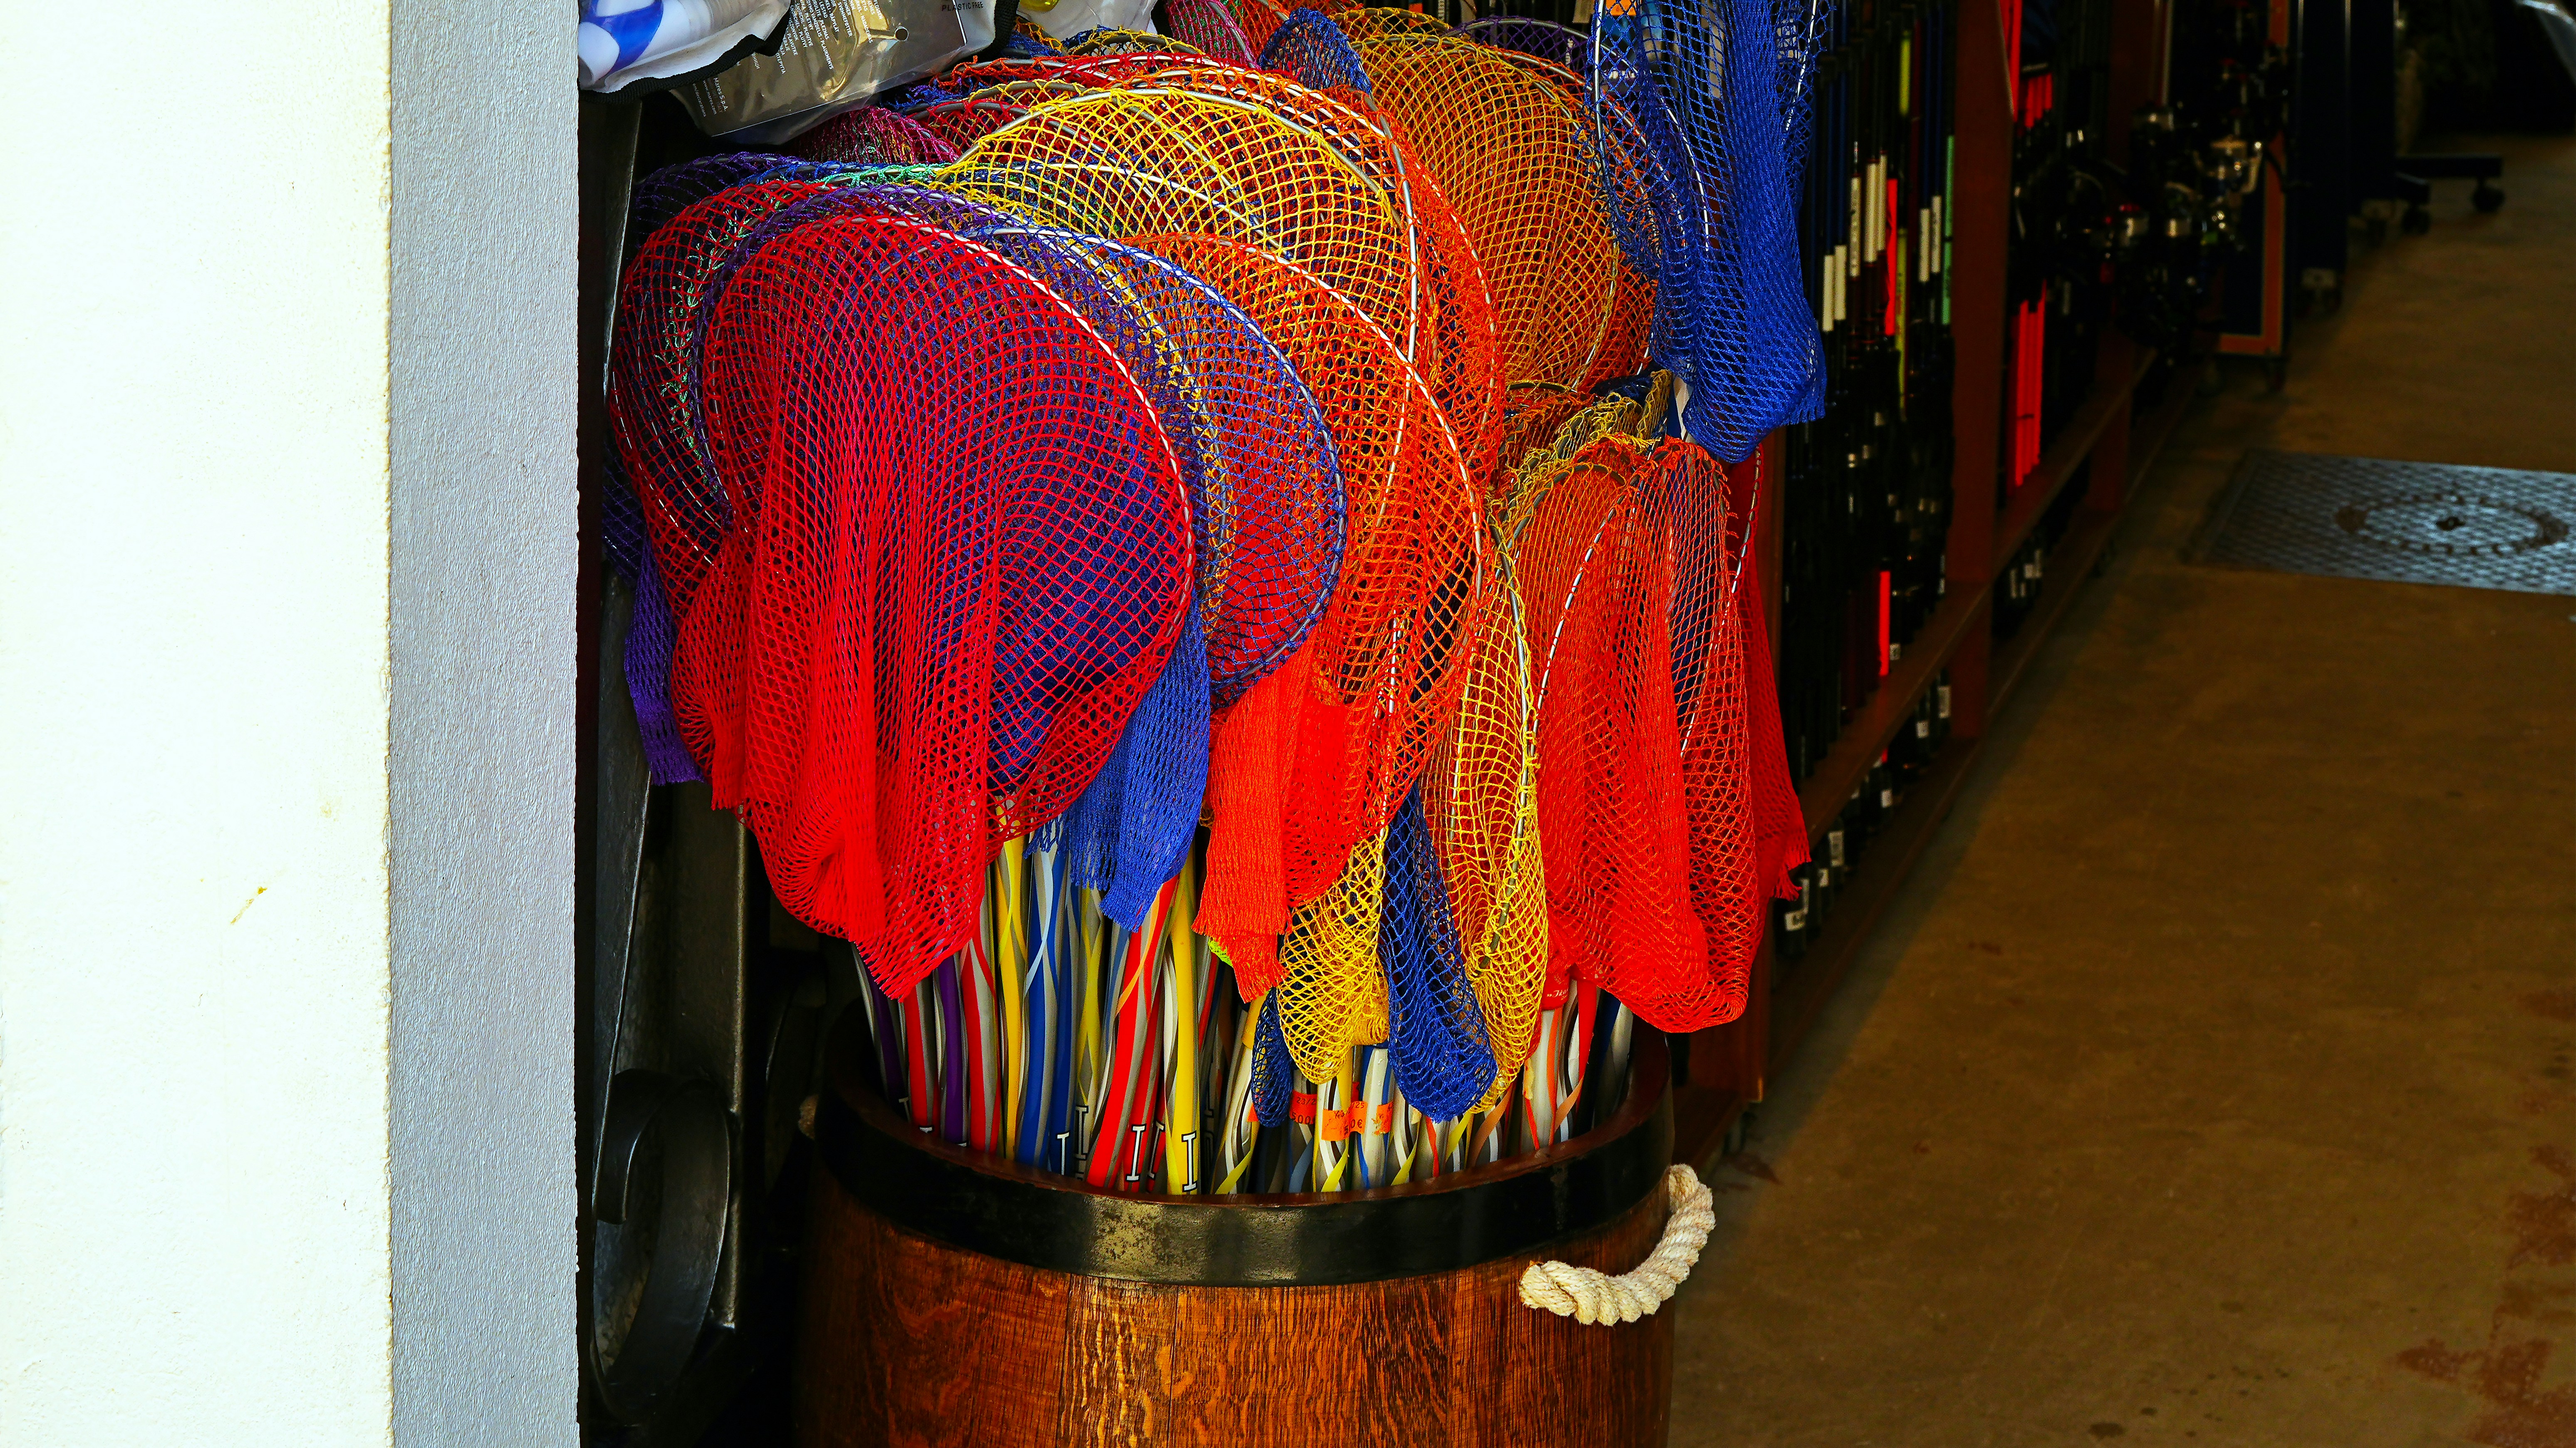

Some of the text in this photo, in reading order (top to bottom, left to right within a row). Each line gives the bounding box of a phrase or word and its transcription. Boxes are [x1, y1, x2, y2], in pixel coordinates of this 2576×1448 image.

[819, 2, 827, 18] LESTAD
[873, 0, 883, 19] FLOSSEN
[942, 3, 971, 11] PLASTIC
[803, 27, 813, 46] PLOUTVE
[820, 20, 829, 40] PLEZNAS
[861, 15, 873, 43] NADADEIRAS
[787, 33, 798, 55] PLAVUTKE
[799, 31, 807, 47] PLUTVY
[811, 13, 822, 37] VAMZDELIS
[820, 40, 833, 69] PLAUKMENYS
[751, 52, 760, 69] ВНИЦИ
[703, 80, 716, 114] www.mares.com
[720, 95, 728, 111] S.p.A.
